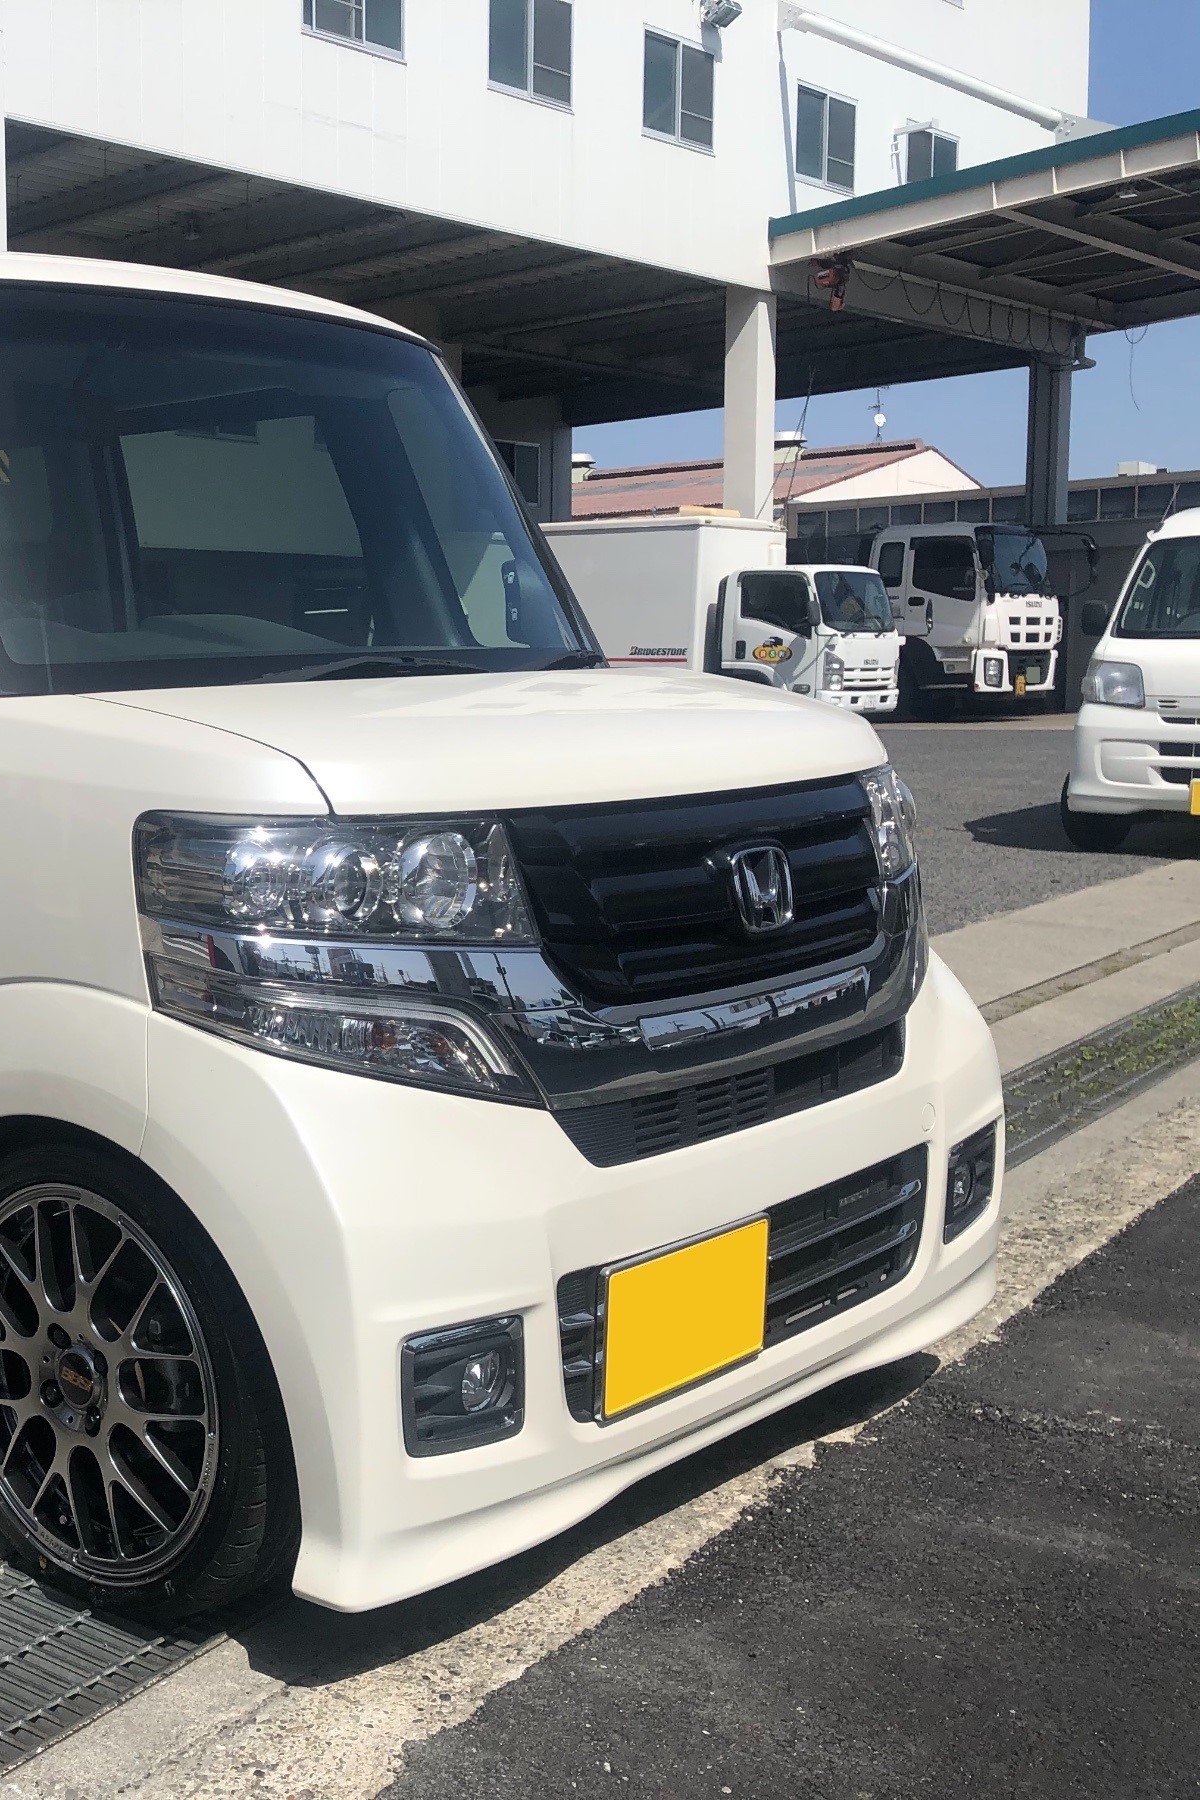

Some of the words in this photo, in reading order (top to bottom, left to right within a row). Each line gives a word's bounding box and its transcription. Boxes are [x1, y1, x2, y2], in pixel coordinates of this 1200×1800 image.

[1025, 600, 1042, 608] ISUZU
[629, 645, 688, 656] BRIDGESTONE
[863, 658, 879, 666] ISUZU
[60, 1365, 94, 1392] BBS
